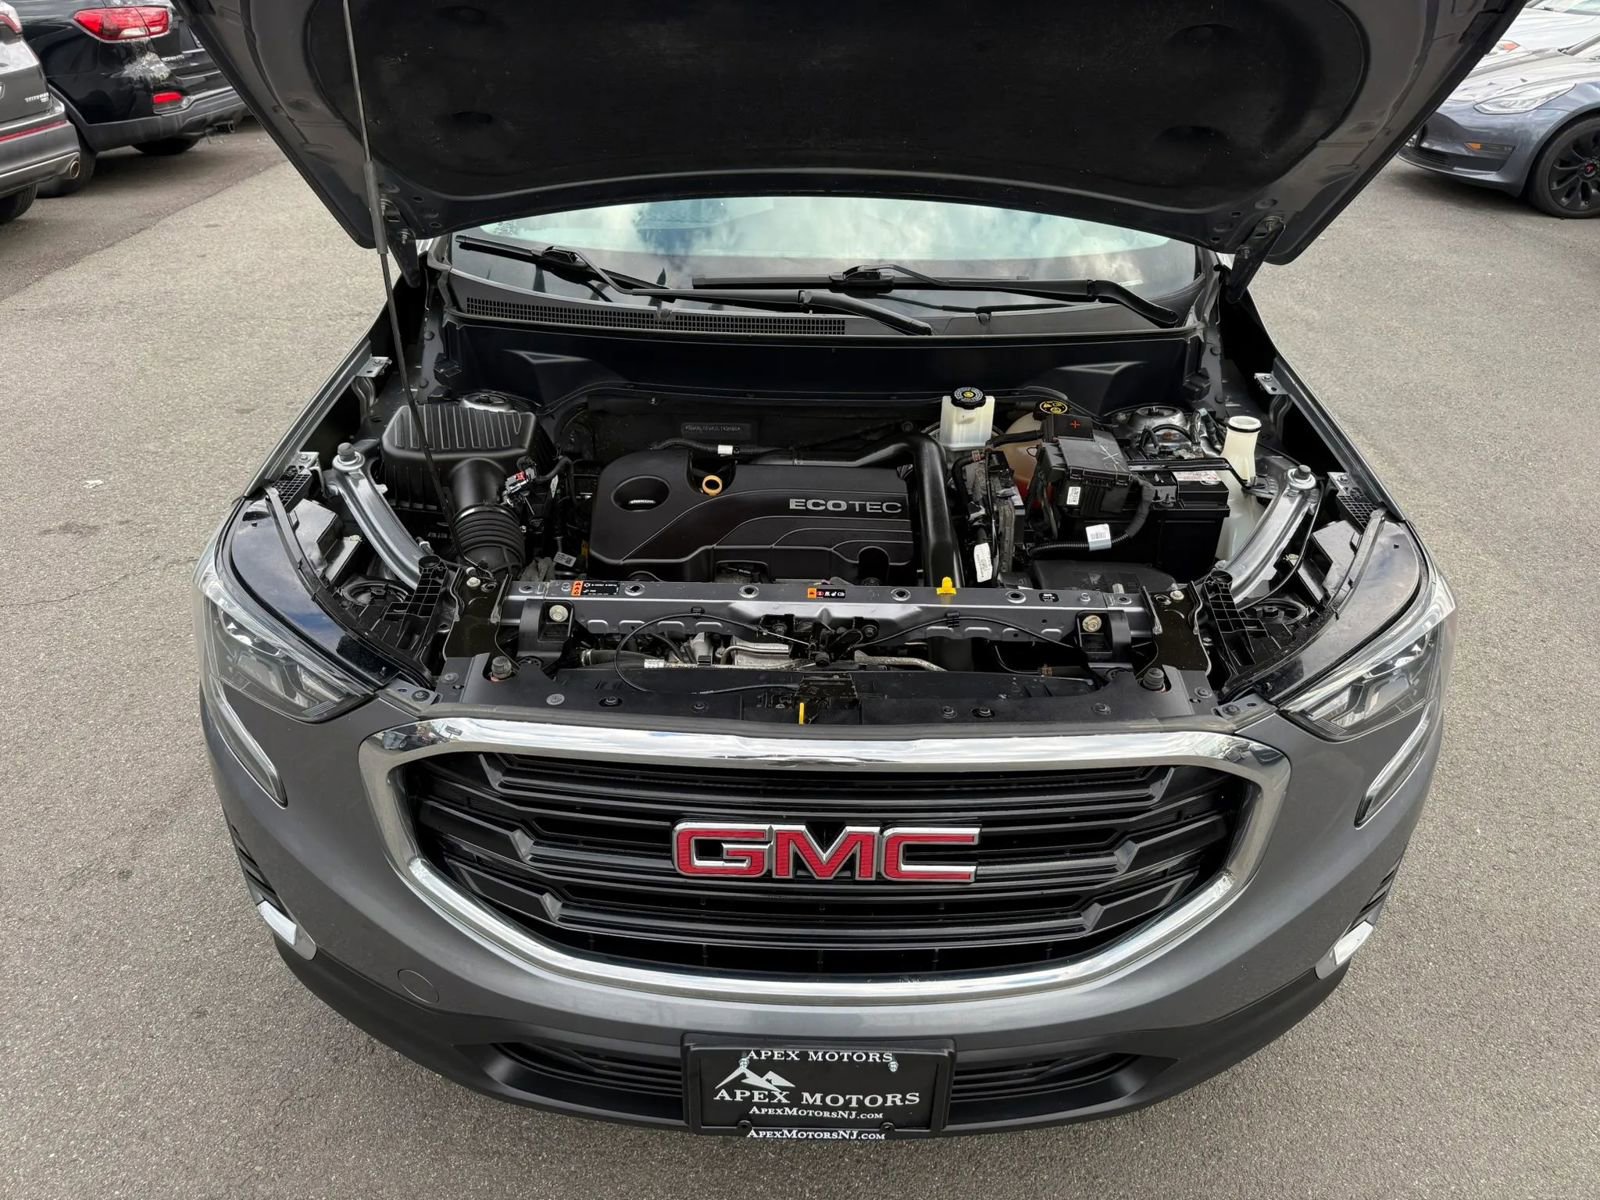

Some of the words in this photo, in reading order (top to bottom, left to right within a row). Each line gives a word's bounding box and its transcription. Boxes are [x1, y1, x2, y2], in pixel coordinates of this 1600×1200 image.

[789, 498, 902, 513] ECOTEC
[673, 822, 981, 882] GMC
[747, 1050, 800, 1061] APEX
[808, 1051, 893, 1063] MOTORS
[713, 1088, 791, 1104] APEX
[801, 1091, 920, 1108] MOTORS
